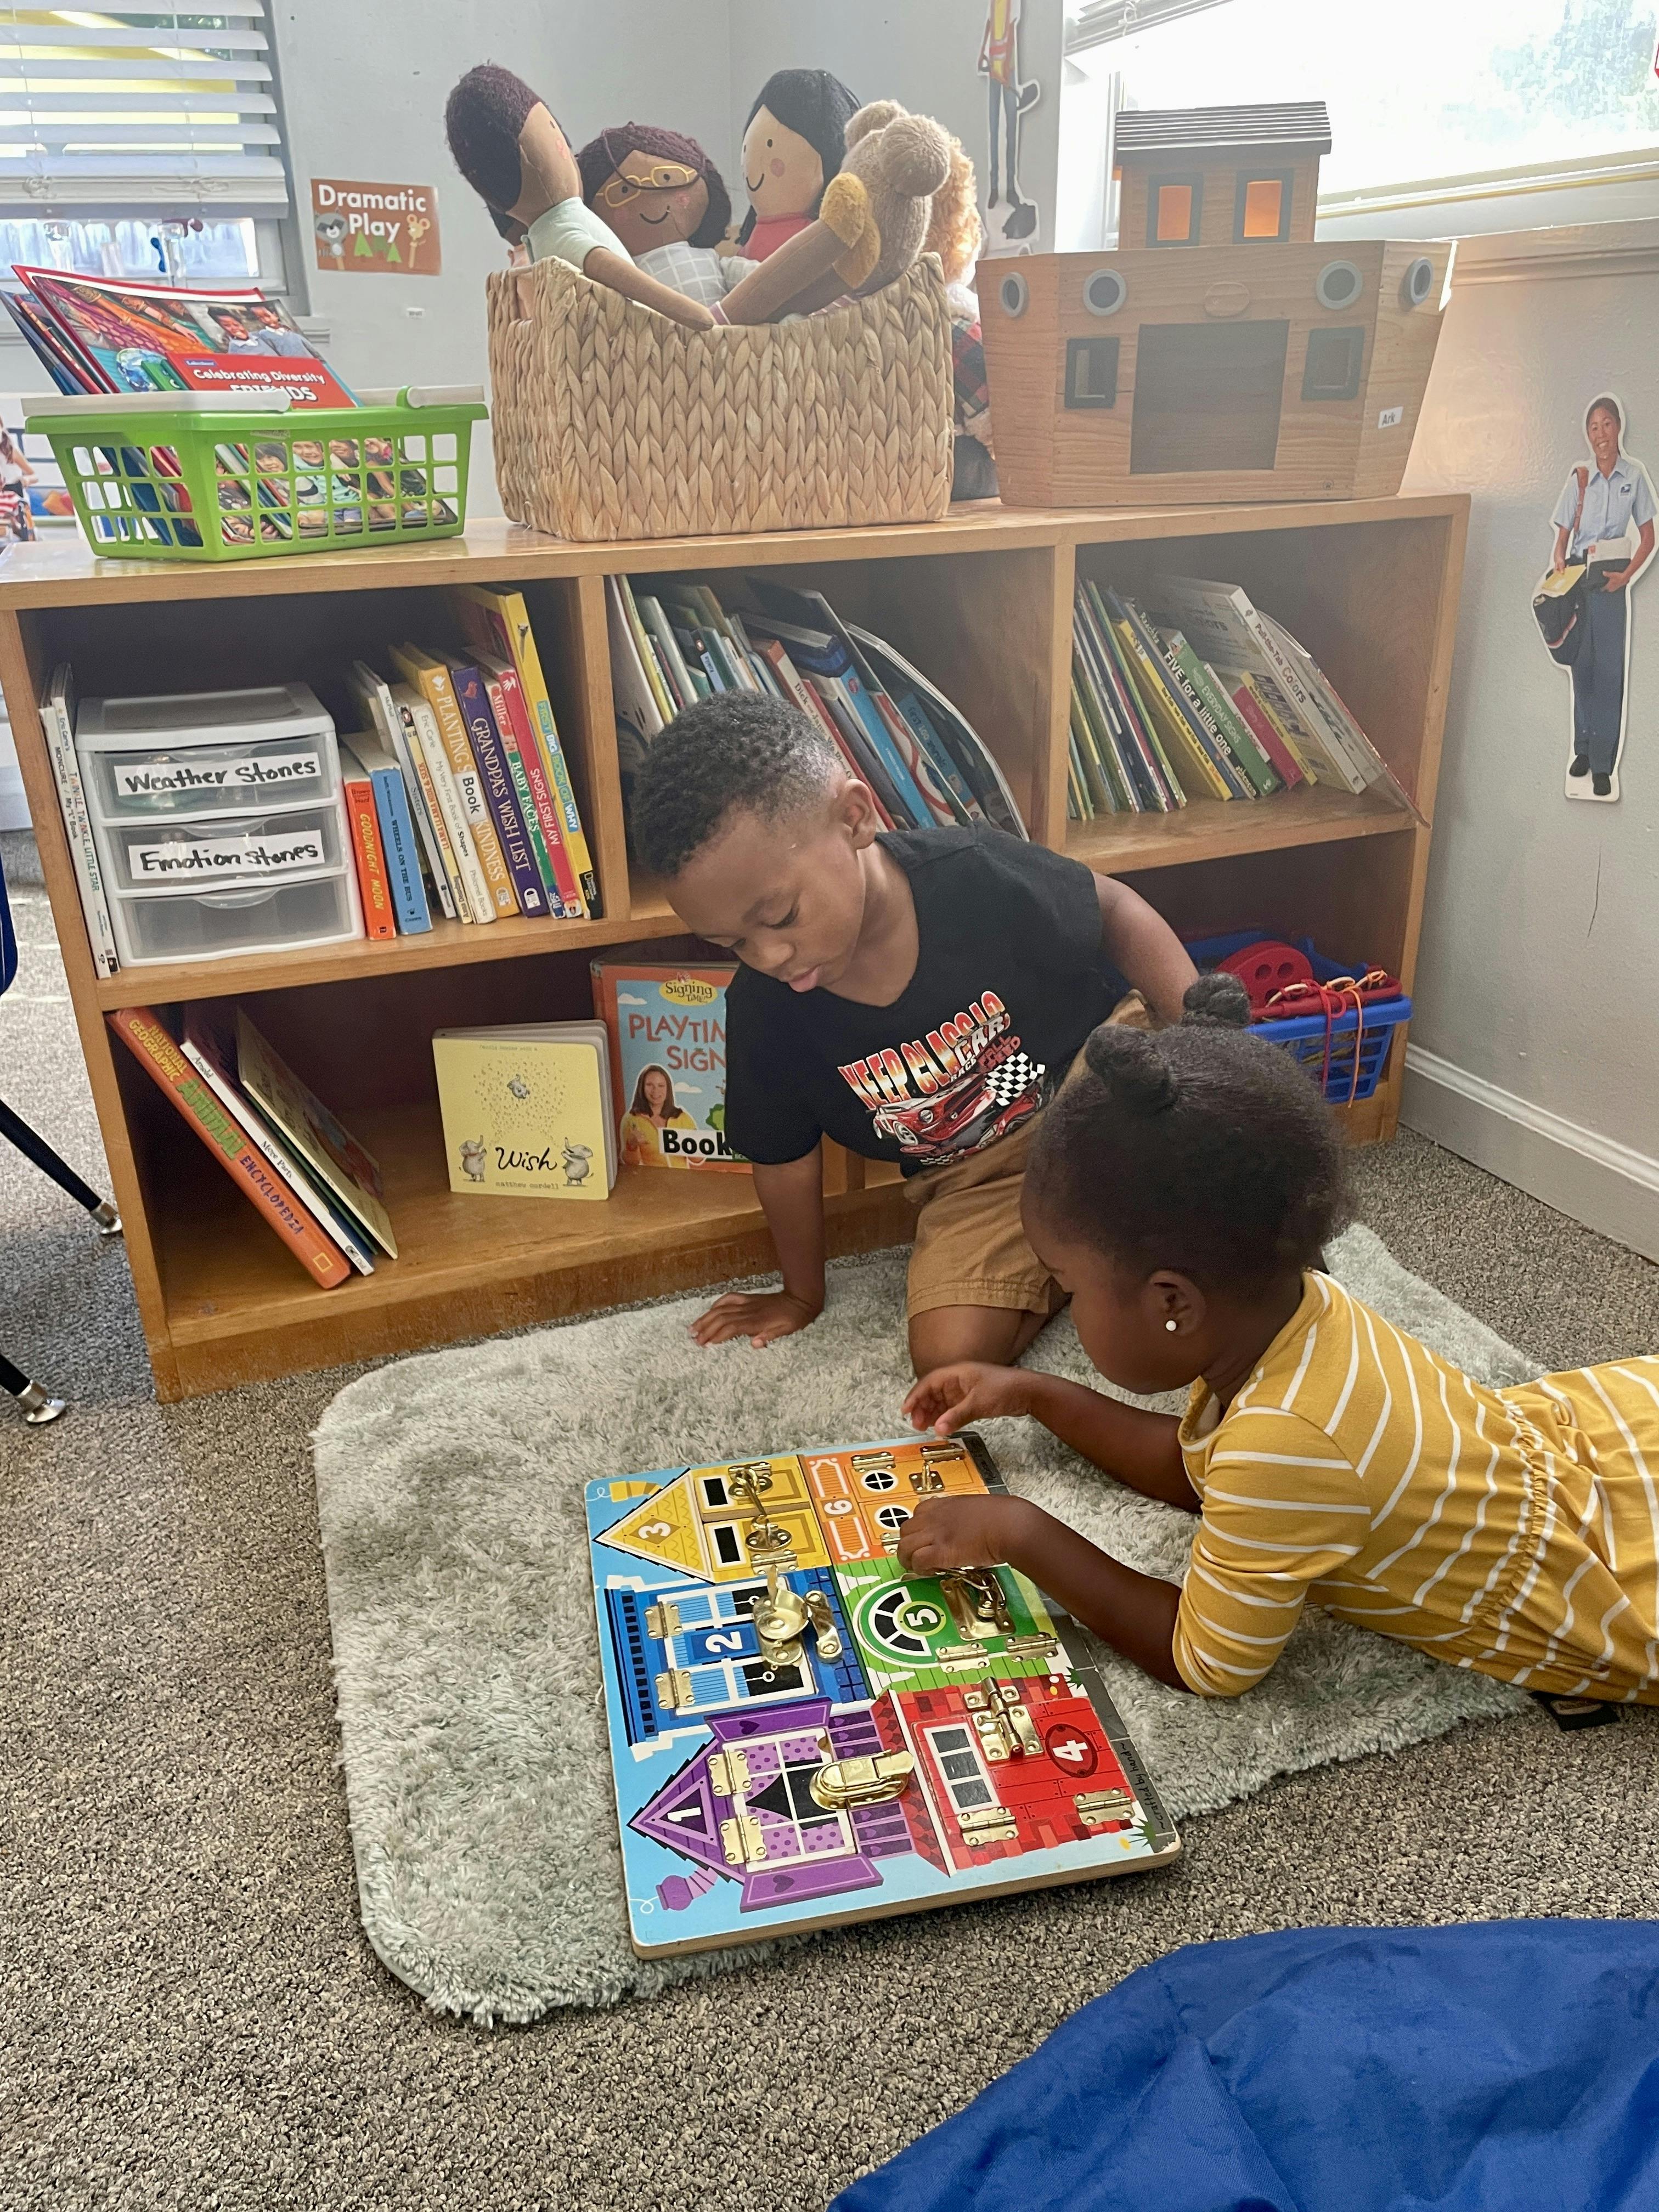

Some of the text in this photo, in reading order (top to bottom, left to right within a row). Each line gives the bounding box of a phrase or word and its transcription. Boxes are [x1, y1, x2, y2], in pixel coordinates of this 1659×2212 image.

[319, 184, 427, 212] Dramatic
[348, 212, 400, 243] Play
[194, 369, 326, 384] Celebrating Diversity
[1382, 412, 1396, 426] Ark
[1255, 623, 1284, 666] Pull-the-Tab
[794, 682, 809, 705] Dick
[1163, 650, 1186, 680] FIVE
[1182, 677, 1197, 698] for
[1193, 698, 1201, 708] a
[1199, 706, 1217, 733] little
[1216, 734, 1232, 756] one
[493, 694, 506, 725] Miller
[1201, 686, 1228, 721] EVERYDAY
[1224, 721, 1241, 744] SIGNS
[437, 695, 469, 764] PLANTING
[126, 760, 316, 792] Weather Stones
[538, 703, 578, 830] FIRST BIG BOOK OF WHY
[55, 747, 67, 784] MONCURE
[65, 798, 72, 808] My
[69, 821, 78, 839] Book
[411, 787, 424, 816] Sisters
[421, 715, 431, 728] Eric
[426, 729, 436, 748] Carle
[436, 761, 442, 771] My
[439, 771, 447, 787] Very
[444, 787, 453, 803] First
[449, 804, 458, 822] Book
[458, 831, 469, 857] Shapes
[462, 777, 481, 814] Book
[471, 717, 532, 871] GRANDPA'S WISH LIST
[511, 761, 539, 833] BABY FACES
[530, 768, 560, 845] MY FIRST SIGNS
[84, 847, 95, 870] LITTLE
[140, 849, 240, 872] Emotion
[360, 814, 380, 875] GOODNIGHT
[371, 879, 384, 910] MOON
[391, 819, 412, 902] WHEELS ON THE BUS
[475, 819, 505, 882] KINDNESS
[89, 872, 100, 891] STAR
[470, 870, 488, 916] Philomel Books
[665, 981, 712, 998] Signing
[129, 1019, 180, 1082] GEOGRAPHIC
[149, 1025, 188, 1073] NATIONAL
[954, 1016, 1005, 1066] CAR
[667, 1045, 726, 1071] SIGN
[951, 1058, 977, 1082] RACE
[838, 1048, 912, 1110] KEEP
[193, 1057, 292, 1178] Arnold More Parts
[176, 1079, 246, 1160] ANIMAL
[240, 1155, 304, 1234] ENCYCLOPEDIA
[662, 1129, 732, 1156] Book
[495, 1147, 557, 1171] Wish
[823, 1499, 852, 1515] 6
[637, 1522, 671, 1539] 3
[904, 1610, 939, 1627] 5
[705, 1631, 743, 1653] 2
[1052, 1740, 1088, 1762] 4
[1135, 1774, 1147, 1785] by
[667, 1807, 701, 1823] 1
